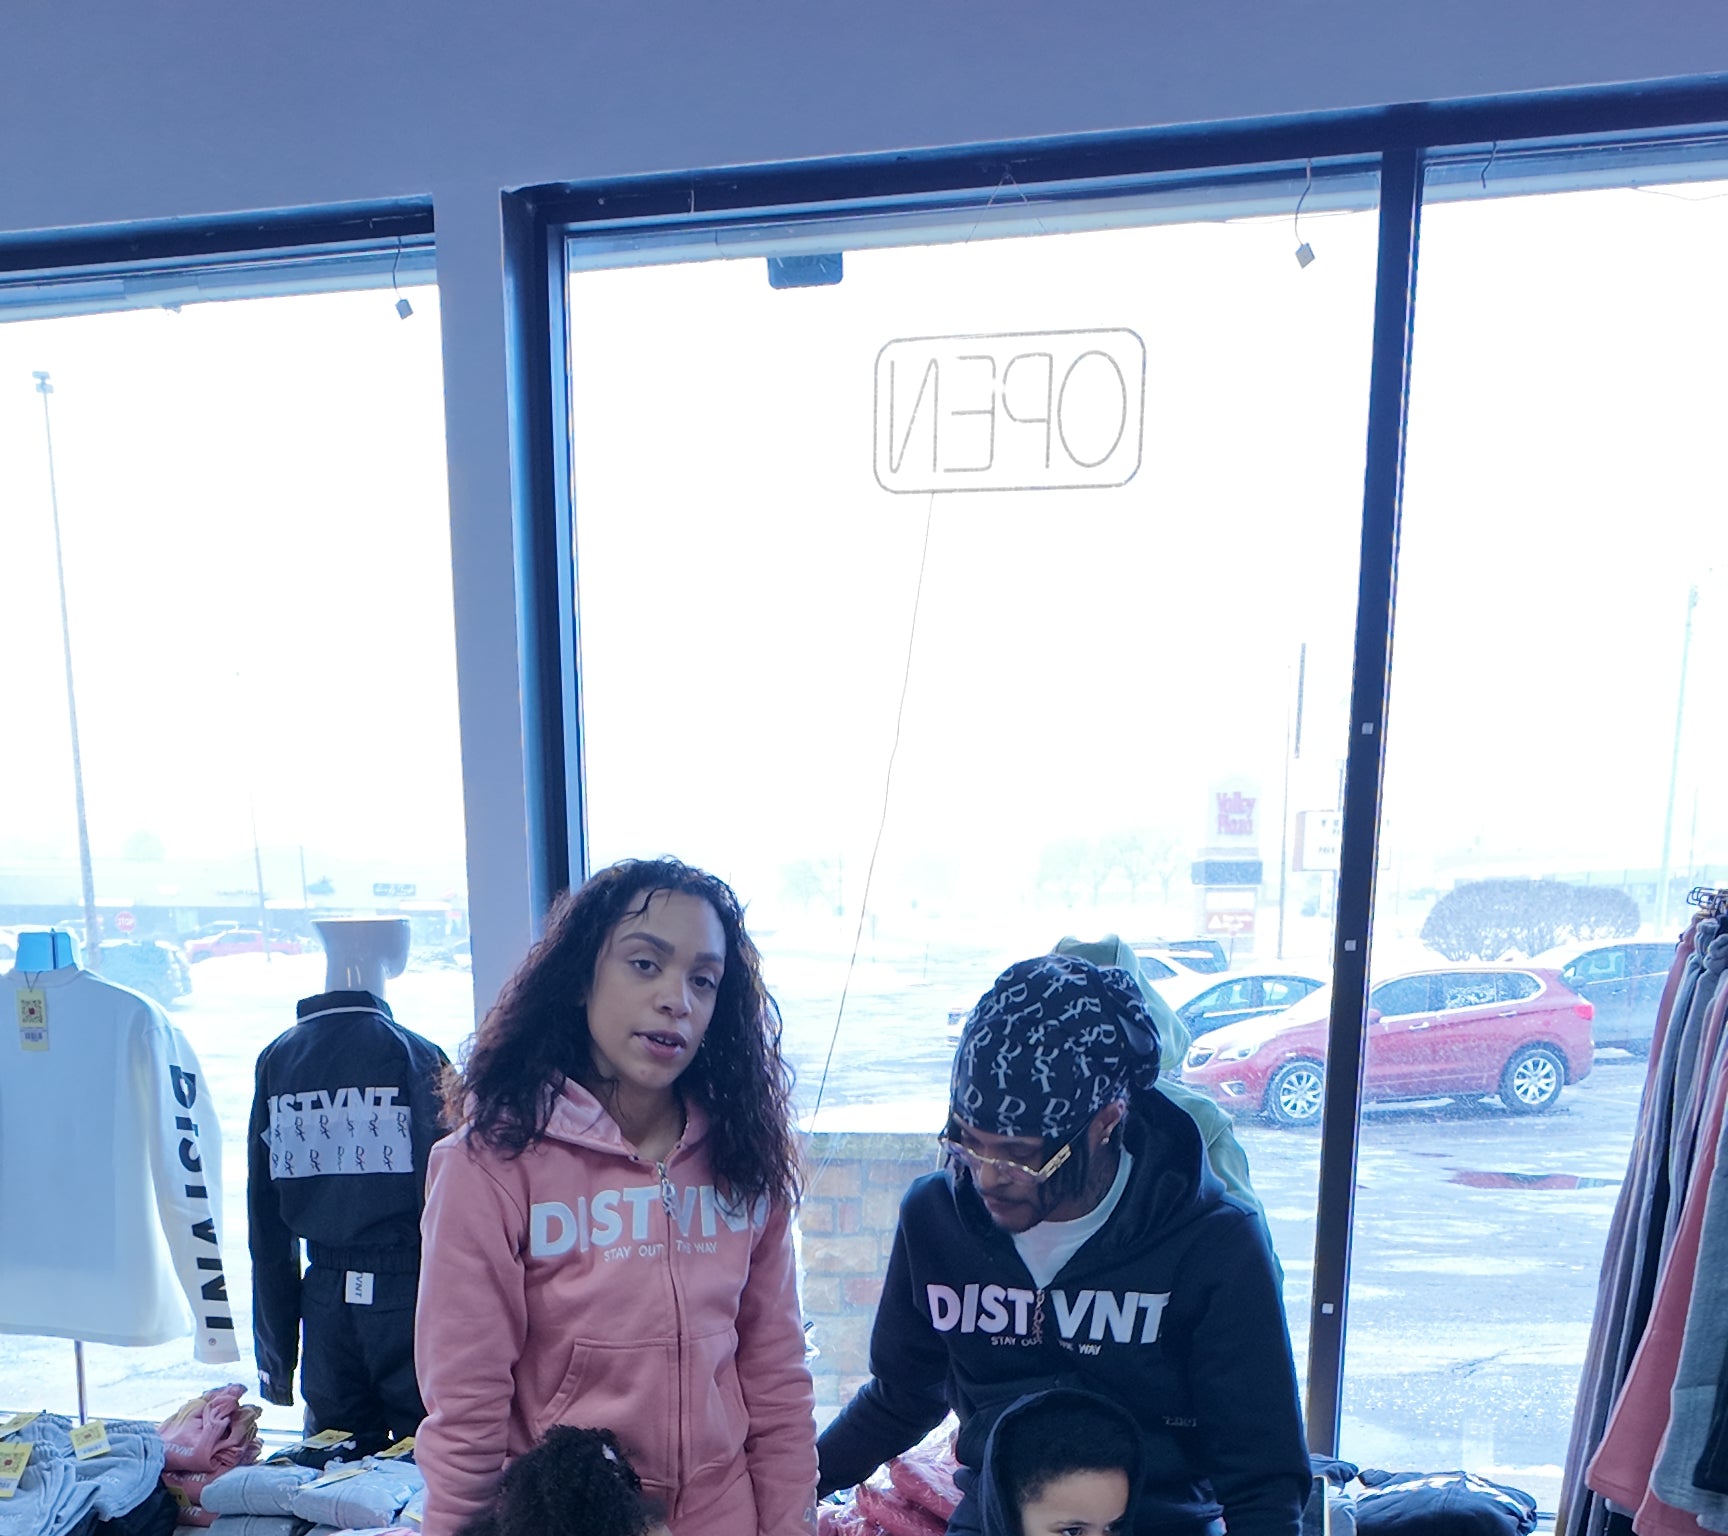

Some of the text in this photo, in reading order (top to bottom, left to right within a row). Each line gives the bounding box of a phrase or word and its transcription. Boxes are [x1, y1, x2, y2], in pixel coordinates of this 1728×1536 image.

[117, 917, 134, 926] STOP
[604, 1246, 632, 1262] STAY
[638, 1243, 665, 1257] OUT
[694, 1241, 717, 1254] WAY
[990, 1337, 1016, 1346] STAY
[1079, 1344, 1101, 1355] WAY
